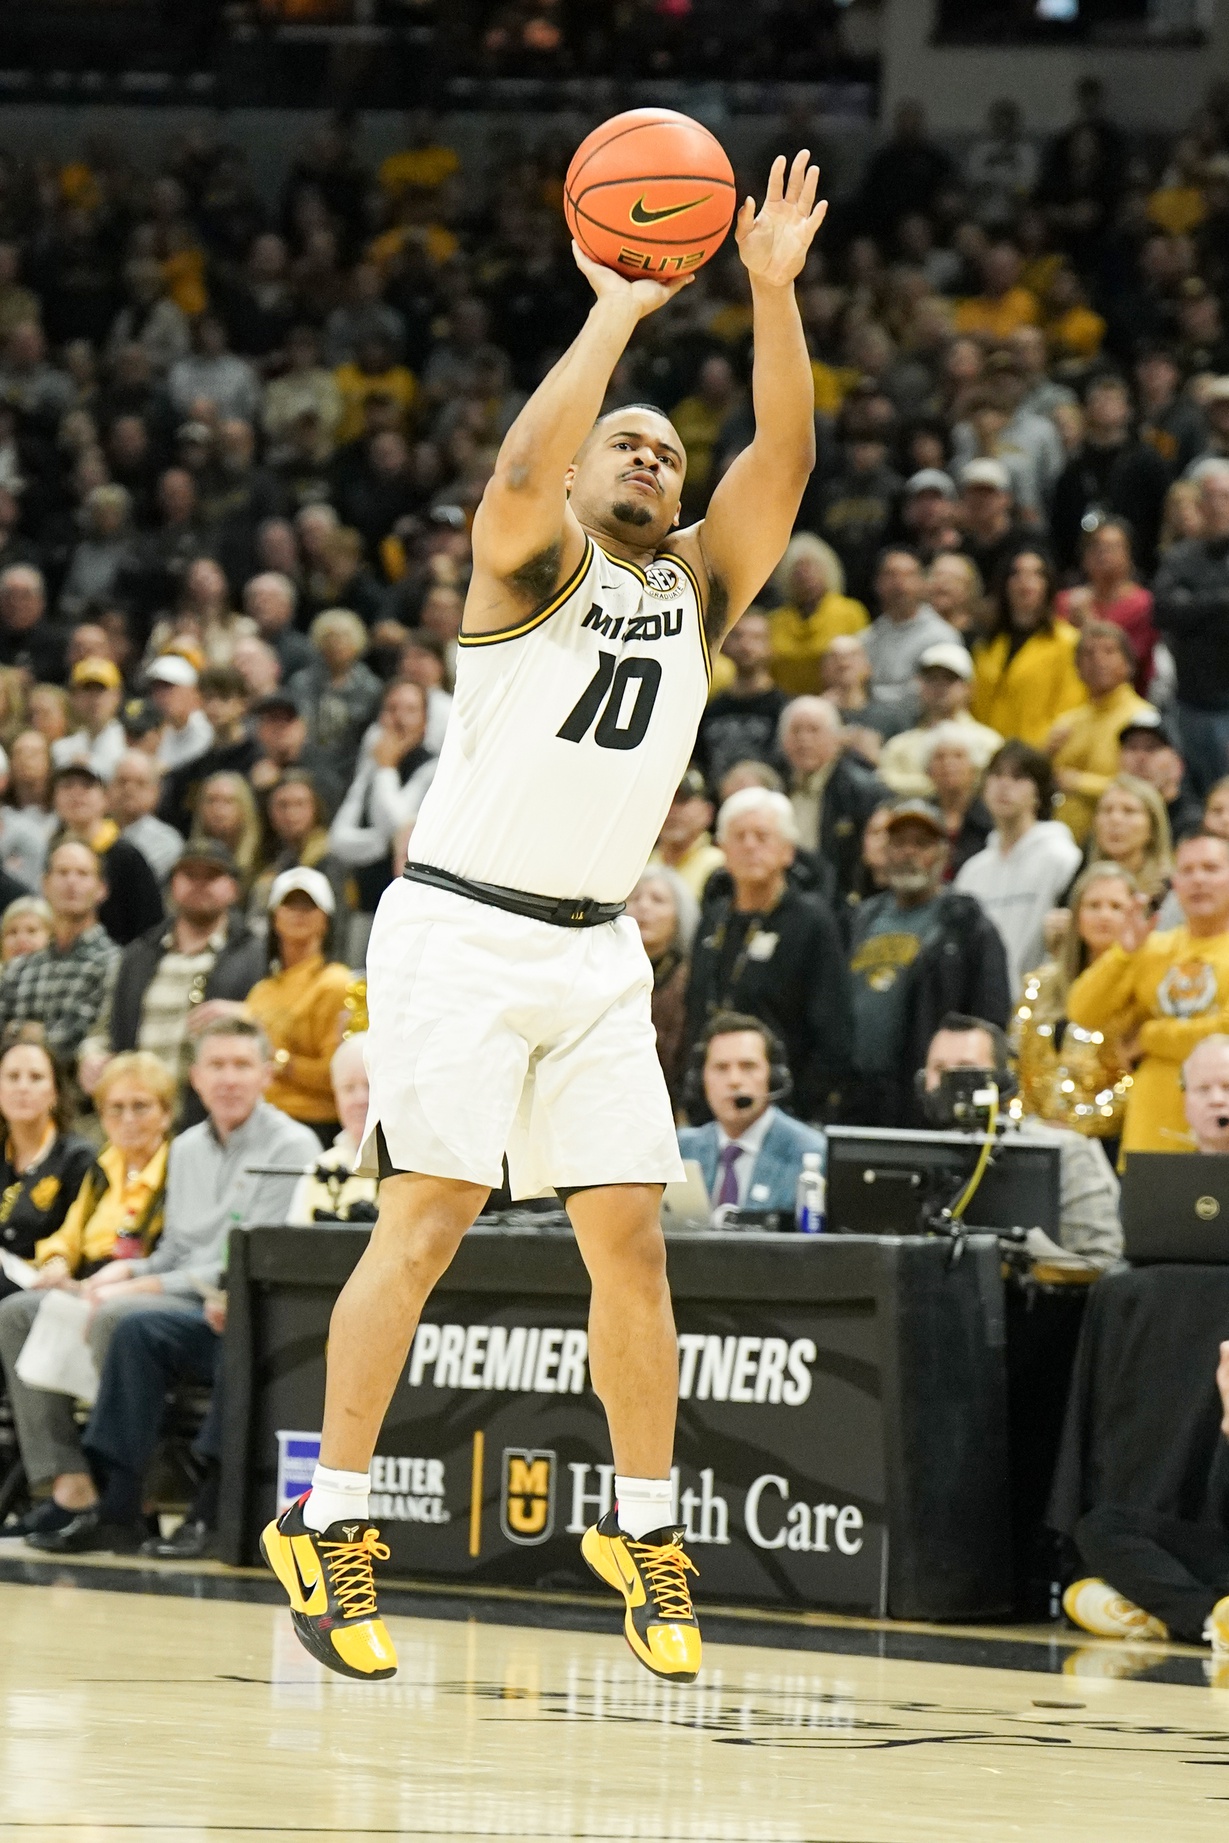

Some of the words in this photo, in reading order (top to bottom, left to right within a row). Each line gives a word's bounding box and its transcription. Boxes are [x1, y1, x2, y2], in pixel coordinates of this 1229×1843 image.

[617, 246, 706, 272] ELITE
[646, 569, 677, 592] SEC
[649, 586, 684, 600] GRADUATE
[581, 602, 684, 643] MIZOU
[555, 650, 663, 750] 10
[408, 1323, 589, 1395] PREMIER
[677, 1333, 818, 1407] TNERS
[371, 1455, 447, 1497] ELTER
[564, 1462, 732, 1545] Hlth
[744, 1474, 865, 1556] Care
